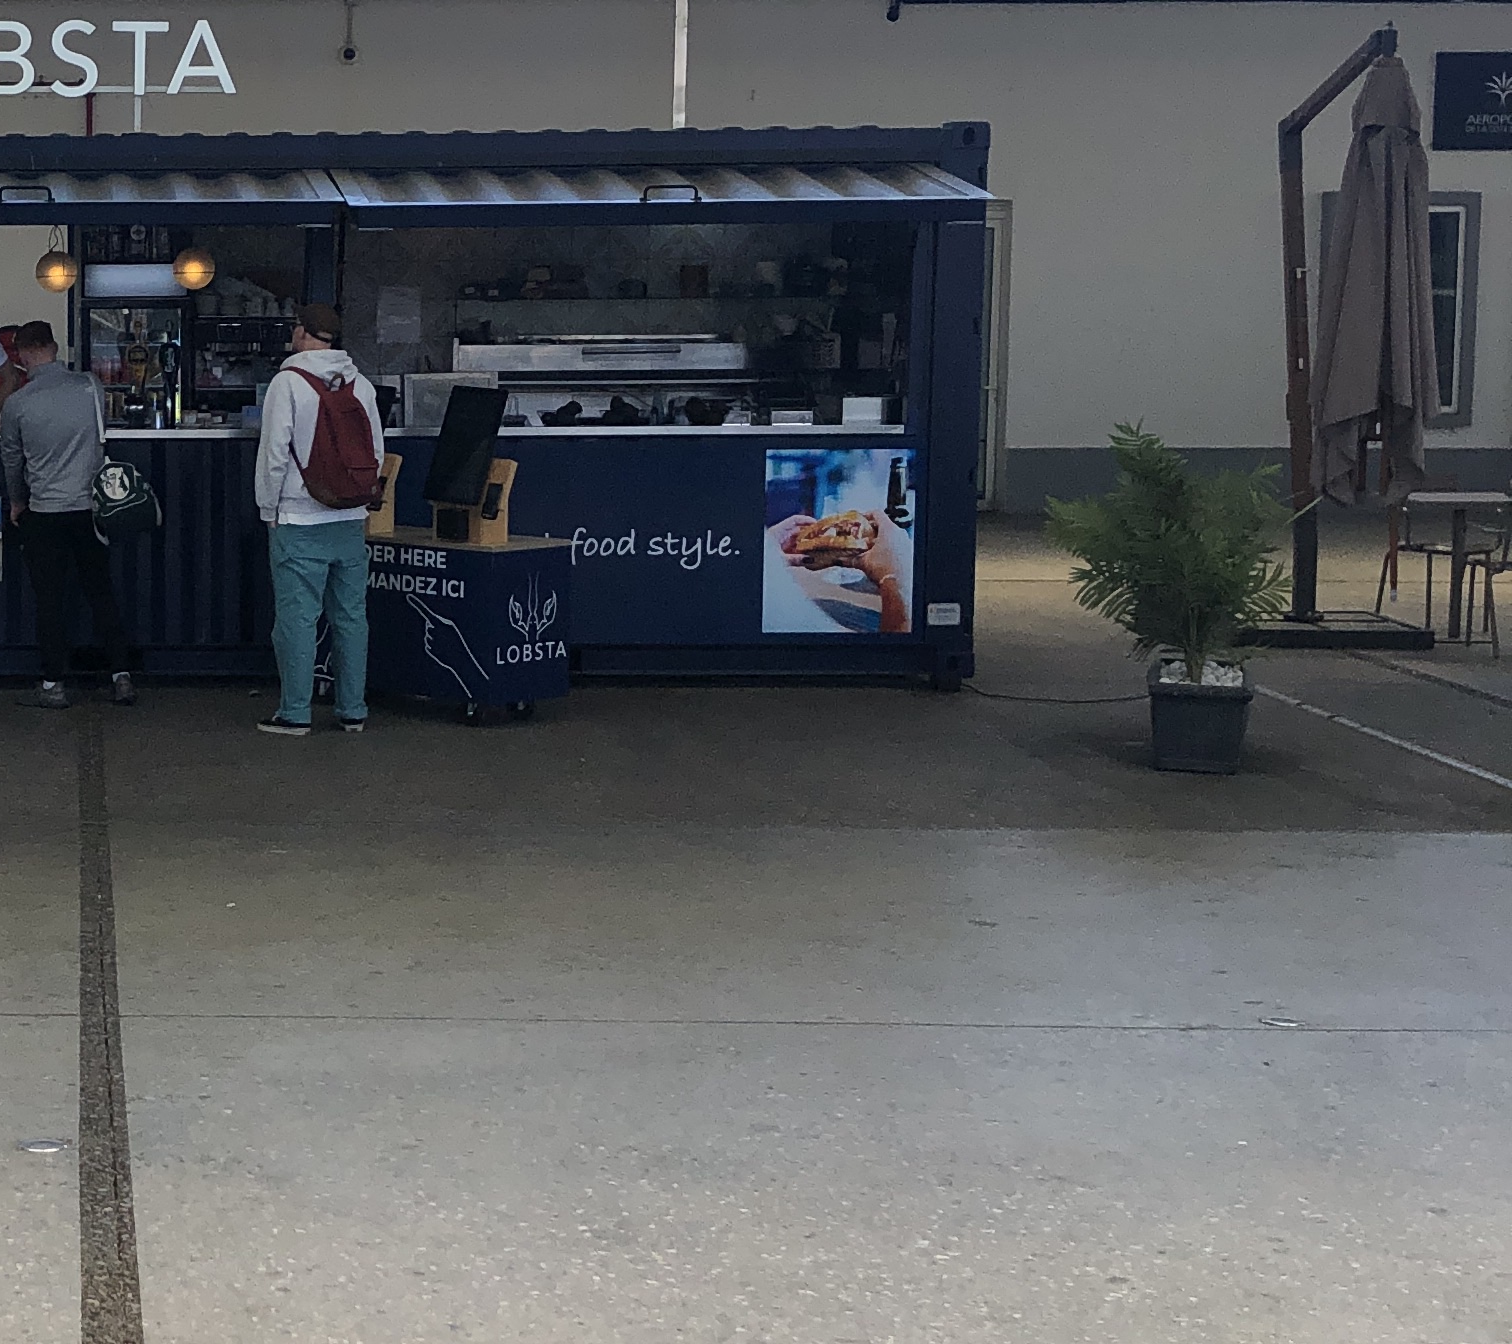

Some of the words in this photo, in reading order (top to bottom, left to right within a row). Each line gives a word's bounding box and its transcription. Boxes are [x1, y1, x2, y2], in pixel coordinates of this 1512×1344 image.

[400, 547, 447, 569] HERE
[571, 527, 636, 566] food
[647, 529, 740, 570] style.
[442, 579, 464, 598] ICI
[496, 640, 567, 665] LOBSTA
